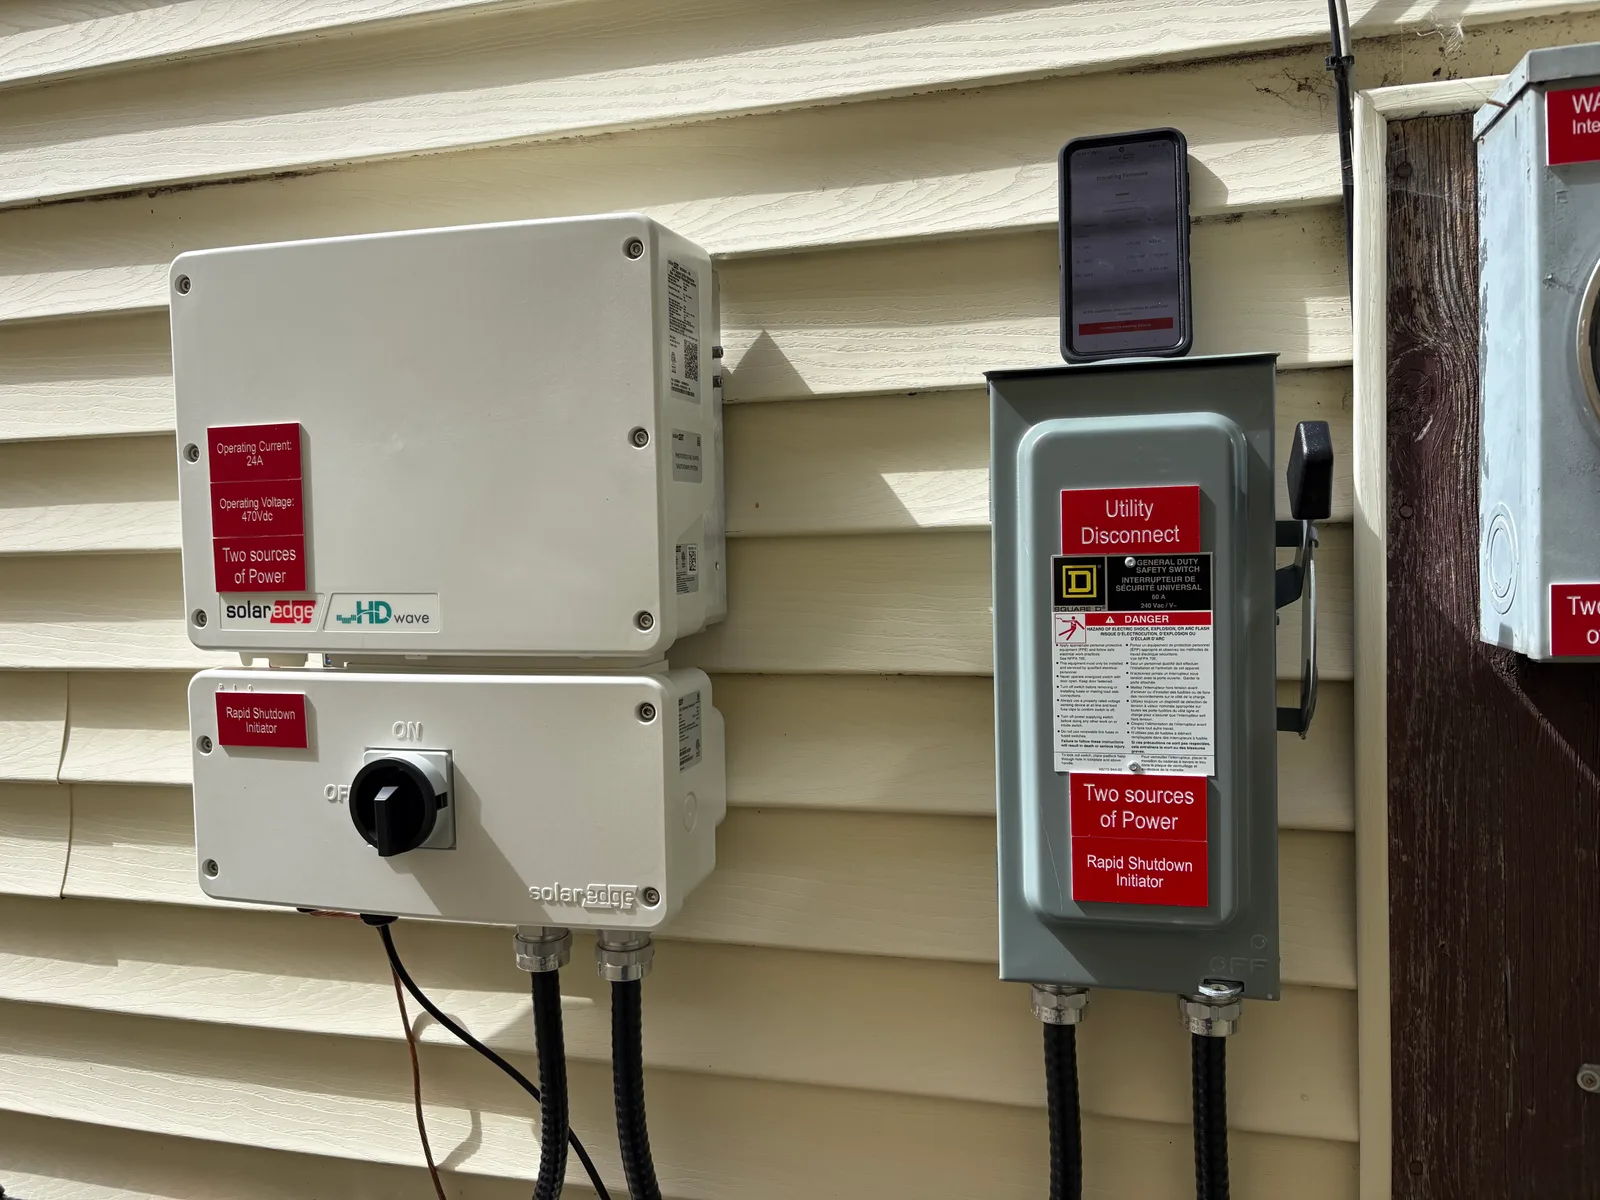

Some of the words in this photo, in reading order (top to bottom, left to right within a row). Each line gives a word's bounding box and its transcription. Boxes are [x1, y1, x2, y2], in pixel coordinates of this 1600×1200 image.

[217, 442, 256, 456] Operating
[259, 441, 292, 452] Current:
[247, 455, 264, 466] 24A
[220, 498, 259, 511] Operating
[261, 497, 294, 509] Voltage:
[1106, 499, 1154, 521] Utility
[242, 511, 273, 522] 470Vdc
[1081, 525, 1180, 545] Disconnect
[222, 547, 246, 562] Two
[250, 549, 296, 562] sources
[234, 569, 245, 584] of
[249, 569, 286, 583] Power
[1122, 576, 1183, 584] INTERRUPTEUR
[1116, 584, 1154, 592] SÉCURITÉ
[226, 600, 316, 624] solaredge
[356, 600, 392, 624] HD
[394, 614, 430, 624] wave
[1125, 615, 1169, 624] DANGER
[226, 707, 251, 721] Rapid
[253, 708, 296, 721] Shutdown
[246, 721, 277, 734] Initiator
[392, 721, 421, 740] ON
[1084, 784, 1119, 802] Two
[1125, 788, 1194, 805] sources
[1100, 810, 1117, 828] of
[1123, 811, 1178, 830] Power
[1087, 855, 1123, 872] Rapid
[1128, 856, 1193, 872] Shutdown
[1116, 874, 1164, 888] Initiator
[1210, 956, 1268, 974] OFF
